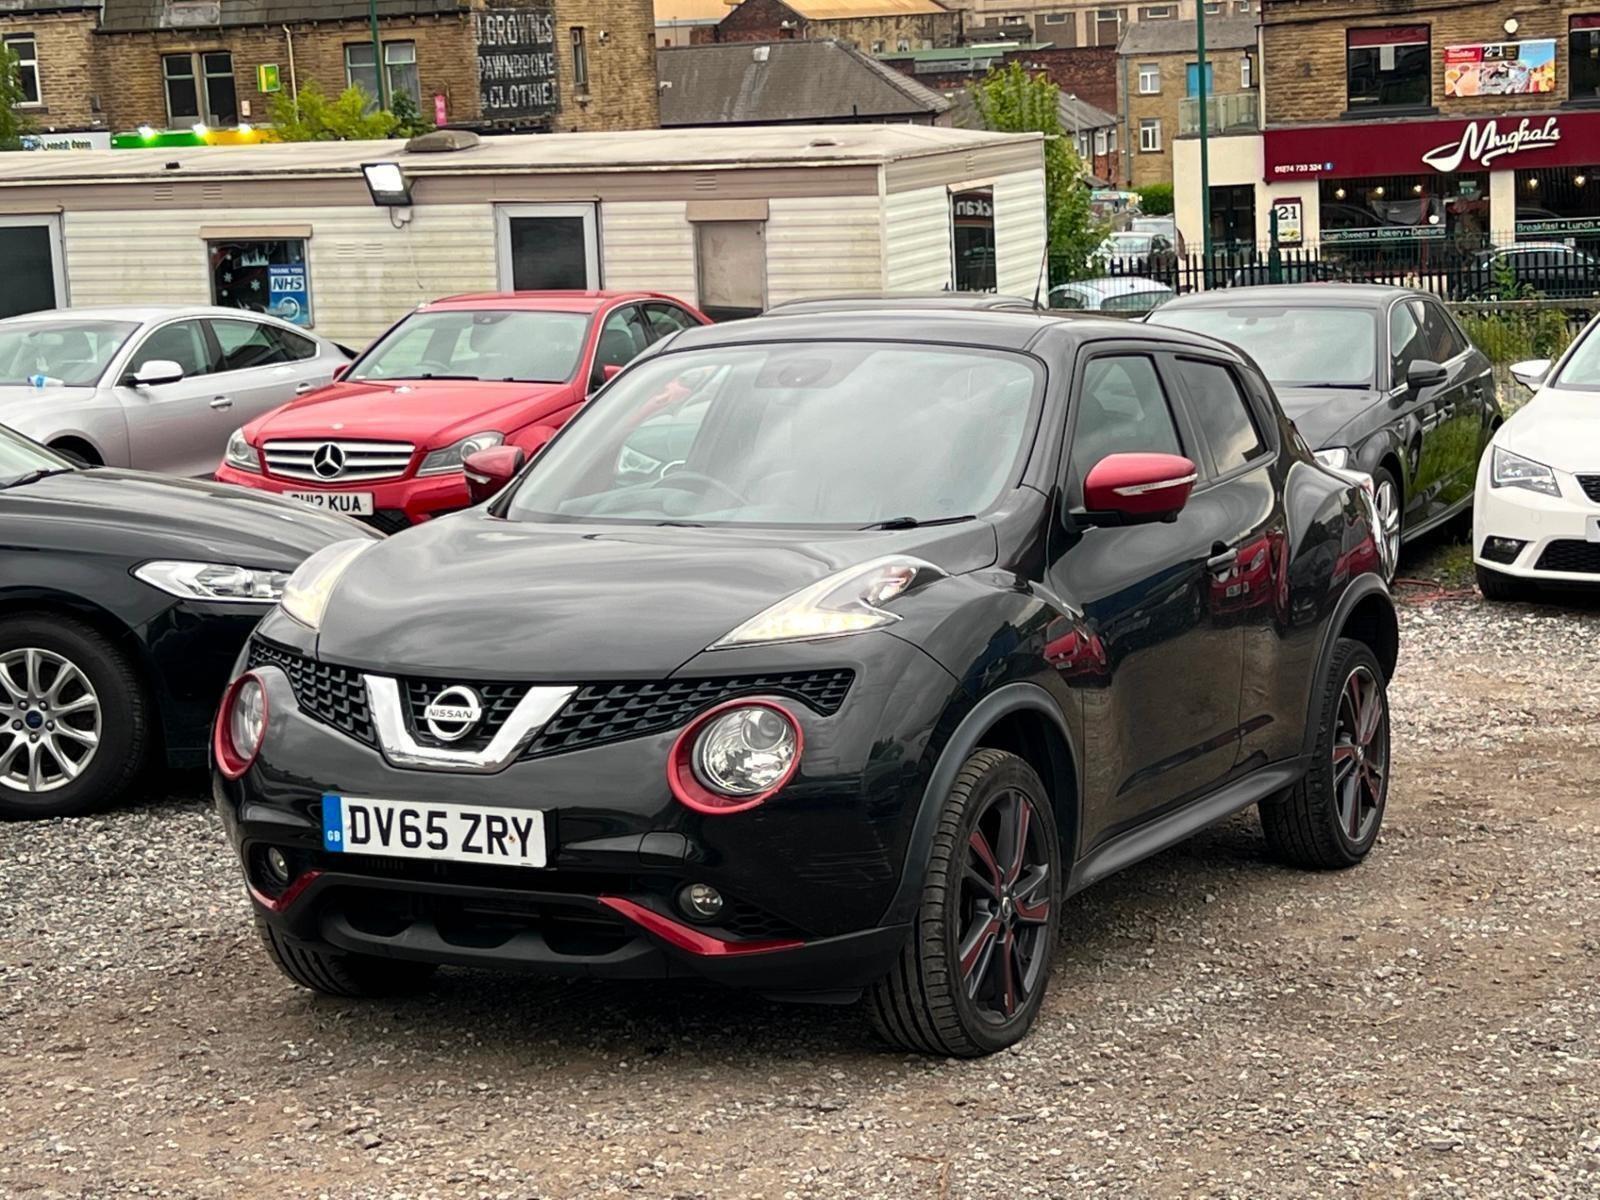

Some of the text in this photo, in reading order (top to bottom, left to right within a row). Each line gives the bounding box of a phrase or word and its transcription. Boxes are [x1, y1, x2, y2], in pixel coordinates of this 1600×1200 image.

[1422, 117, 1560, 172] Mughals
[1517, 220, 1594, 232] Breakfast Lunch
[272, 277, 303, 291] NHS
[328, 495, 362, 513] KUA
[429, 708, 473, 719] NISSAN
[349, 804, 534, 858] DV65 ZRY
